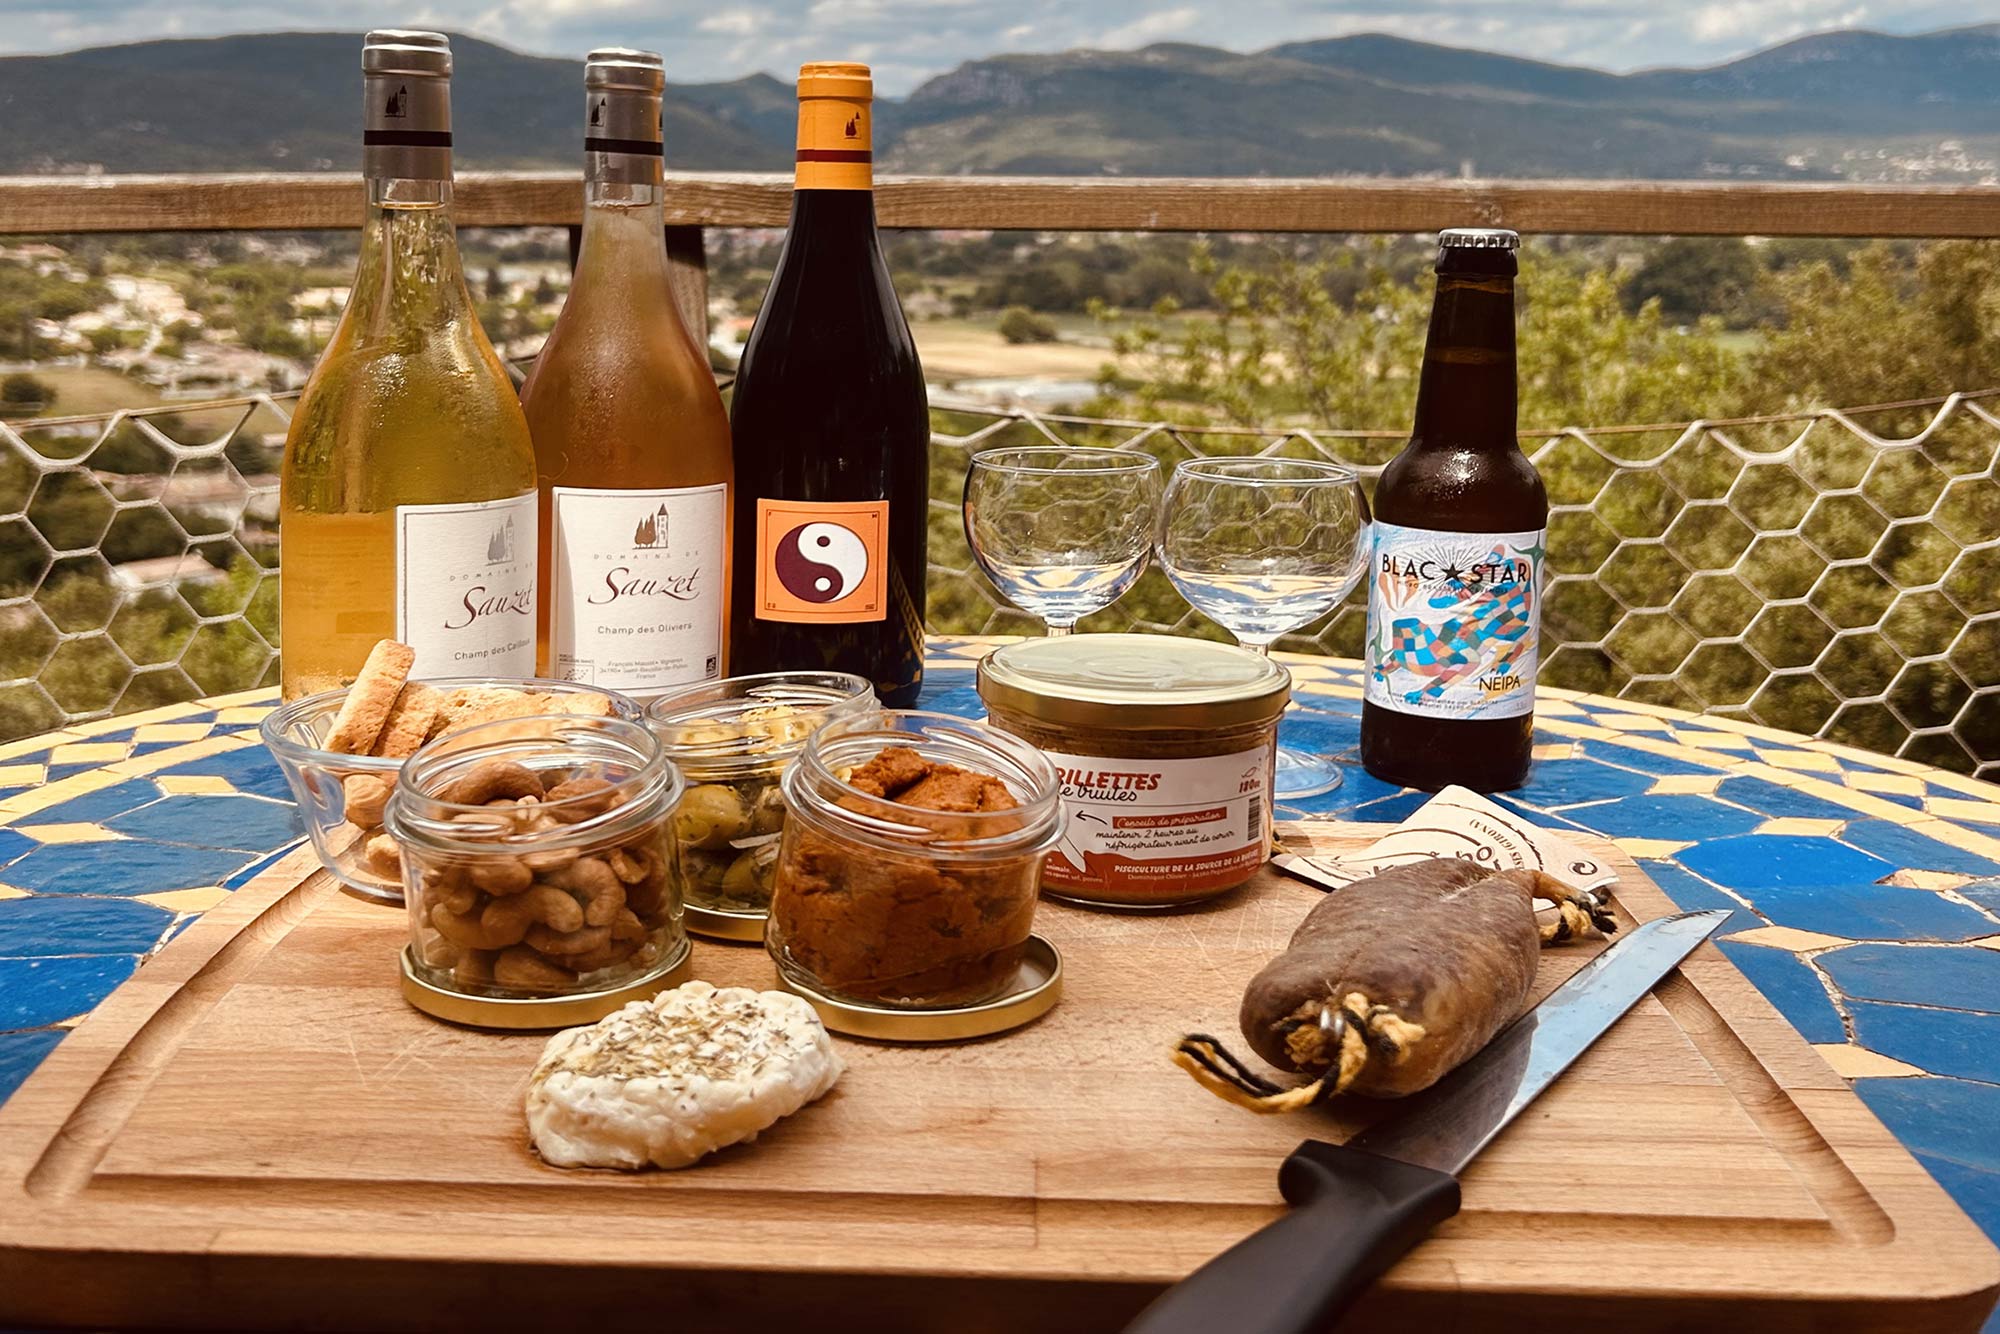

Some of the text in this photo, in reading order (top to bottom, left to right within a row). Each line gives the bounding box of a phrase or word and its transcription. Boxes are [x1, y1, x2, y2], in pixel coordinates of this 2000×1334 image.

[593, 552, 672, 560] DOMAINE
[587, 567, 700, 605] Sauzet
[444, 580, 534, 630] Sauzet
[597, 622, 693, 635] Champ des Oliviers
[454, 650, 489, 661] Champ
[491, 646, 506, 655] des
[1479, 675, 1521, 691] NEIPA
[1056, 767, 1162, 791] RILLETTES
[1117, 816, 1156, 829] Conseils
[1157, 816, 1169, 826] de
[1096, 830, 1141, 839] maintenir
[1144, 829, 1152, 839] 2
[1154, 829, 1185, 838] heures
[1105, 839, 1173, 852] réfrigérateur
[1174, 835, 1200, 846] avant
[1200, 834, 1211, 843] de
[1114, 864, 1171, 874] PISCICULTURE
[1172, 864, 1184, 873] DE
[1184, 863, 1195, 872] LA
[1195, 859, 1223, 871] SOURCE
[1223, 857, 1233, 866] DE
